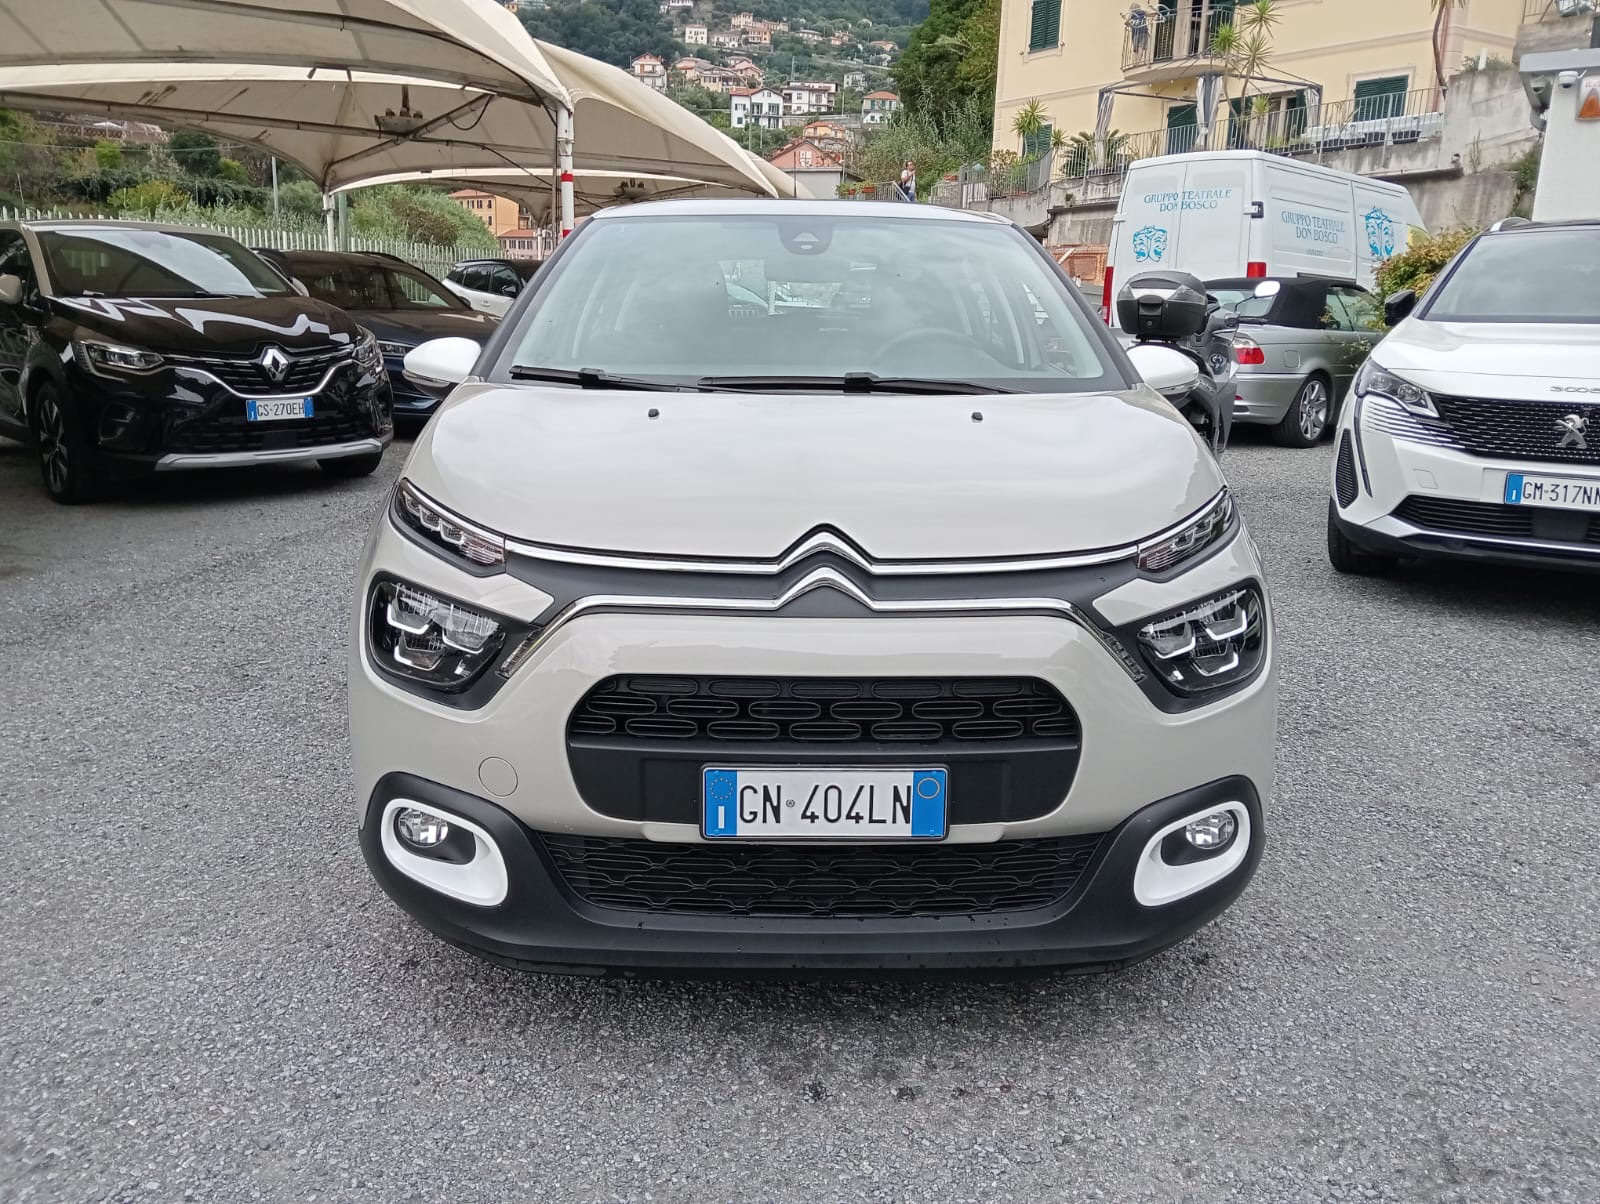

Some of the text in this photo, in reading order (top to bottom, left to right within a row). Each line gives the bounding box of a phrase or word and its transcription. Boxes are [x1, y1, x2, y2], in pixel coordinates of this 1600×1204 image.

[1144, 189, 1232, 204] GRUPPO TEATRALE
[1181, 200, 1218, 210] BOSCO
[1281, 210, 1345, 233] GRUPPO TEATRALE
[1296, 226, 1338, 244] DON BOSCO
[1523, 481, 1544, 500] GM
[739, 784, 912, 824] GN 404LN
